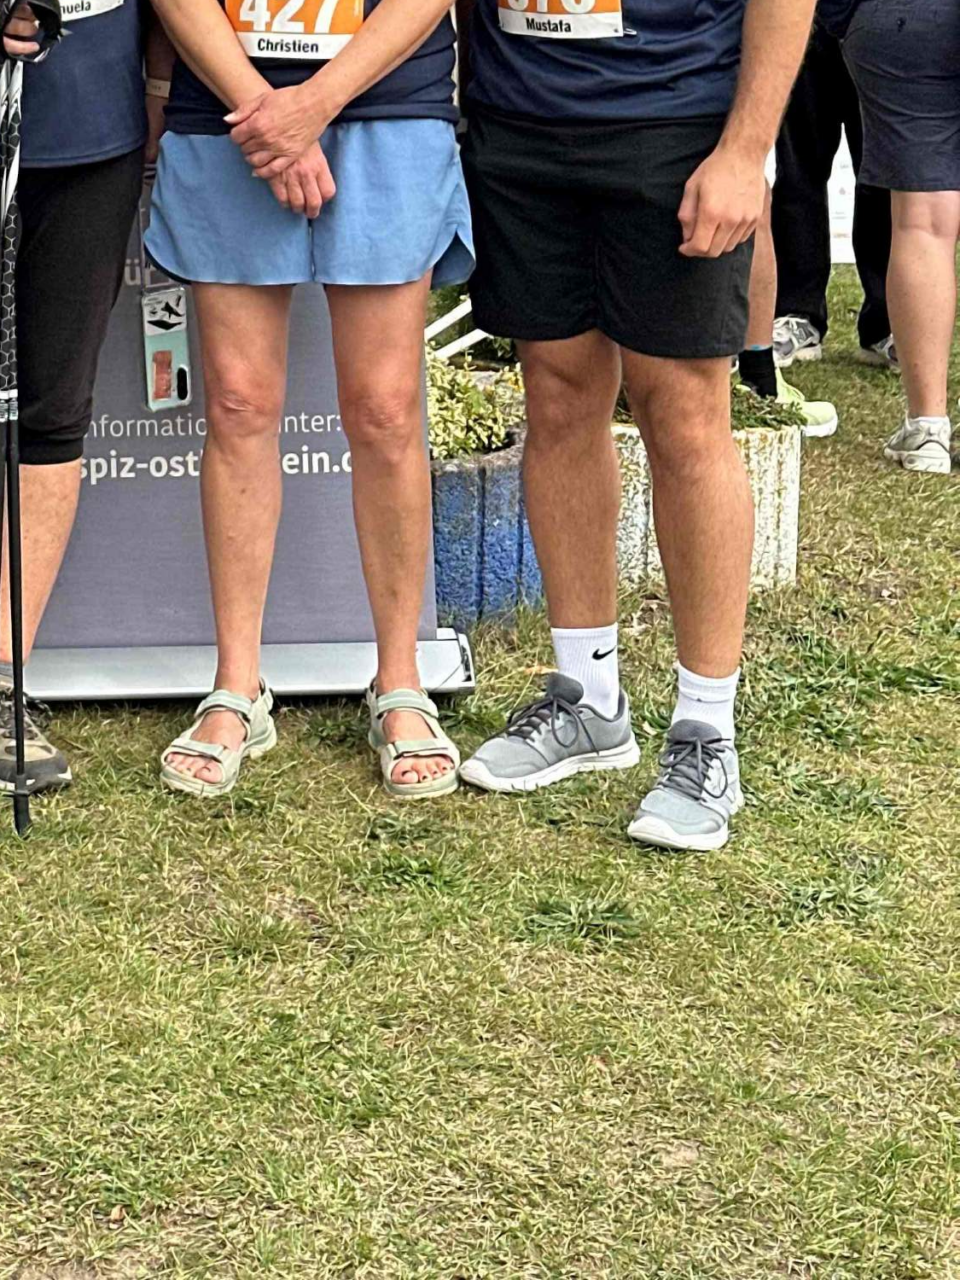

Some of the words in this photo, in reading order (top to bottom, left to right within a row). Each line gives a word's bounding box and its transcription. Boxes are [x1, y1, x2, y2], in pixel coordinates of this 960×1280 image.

[60, 0, 92, 15] nuela
[525, 18, 572, 34] Mustafa
[257, 37, 319, 54] Christien
[279, 414, 342, 433] nter:
